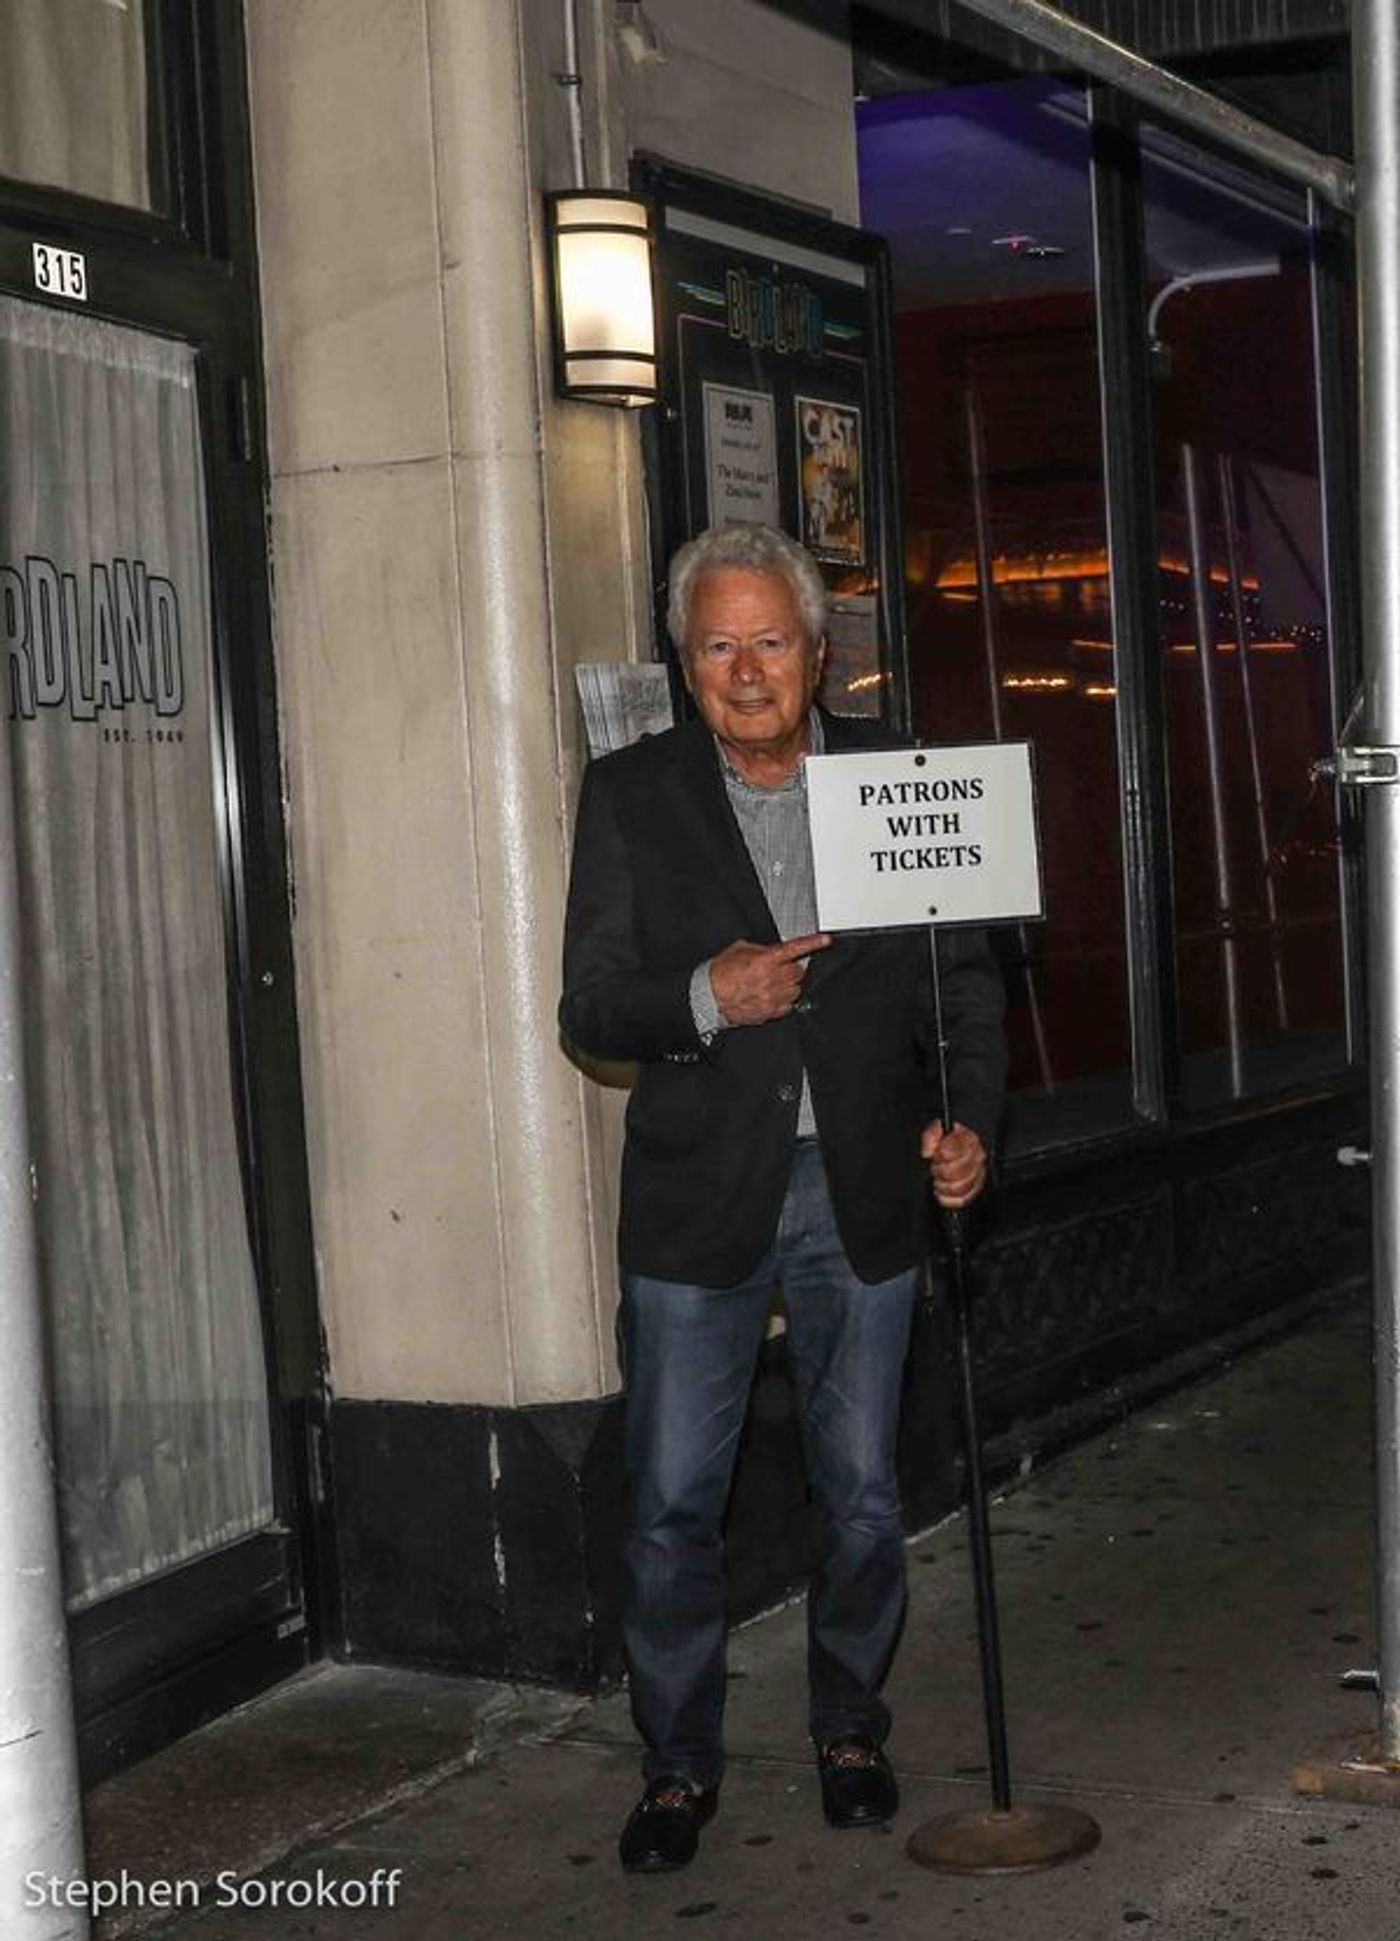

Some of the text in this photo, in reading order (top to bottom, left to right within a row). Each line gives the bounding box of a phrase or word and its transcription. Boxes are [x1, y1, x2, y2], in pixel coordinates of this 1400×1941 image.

[37, 247, 83, 295] 315
[0, 555, 185, 722] RDLAND
[859, 777, 984, 806] PATRONS
[886, 812, 961, 838] WITH
[870, 844, 983, 872] TICKETS
